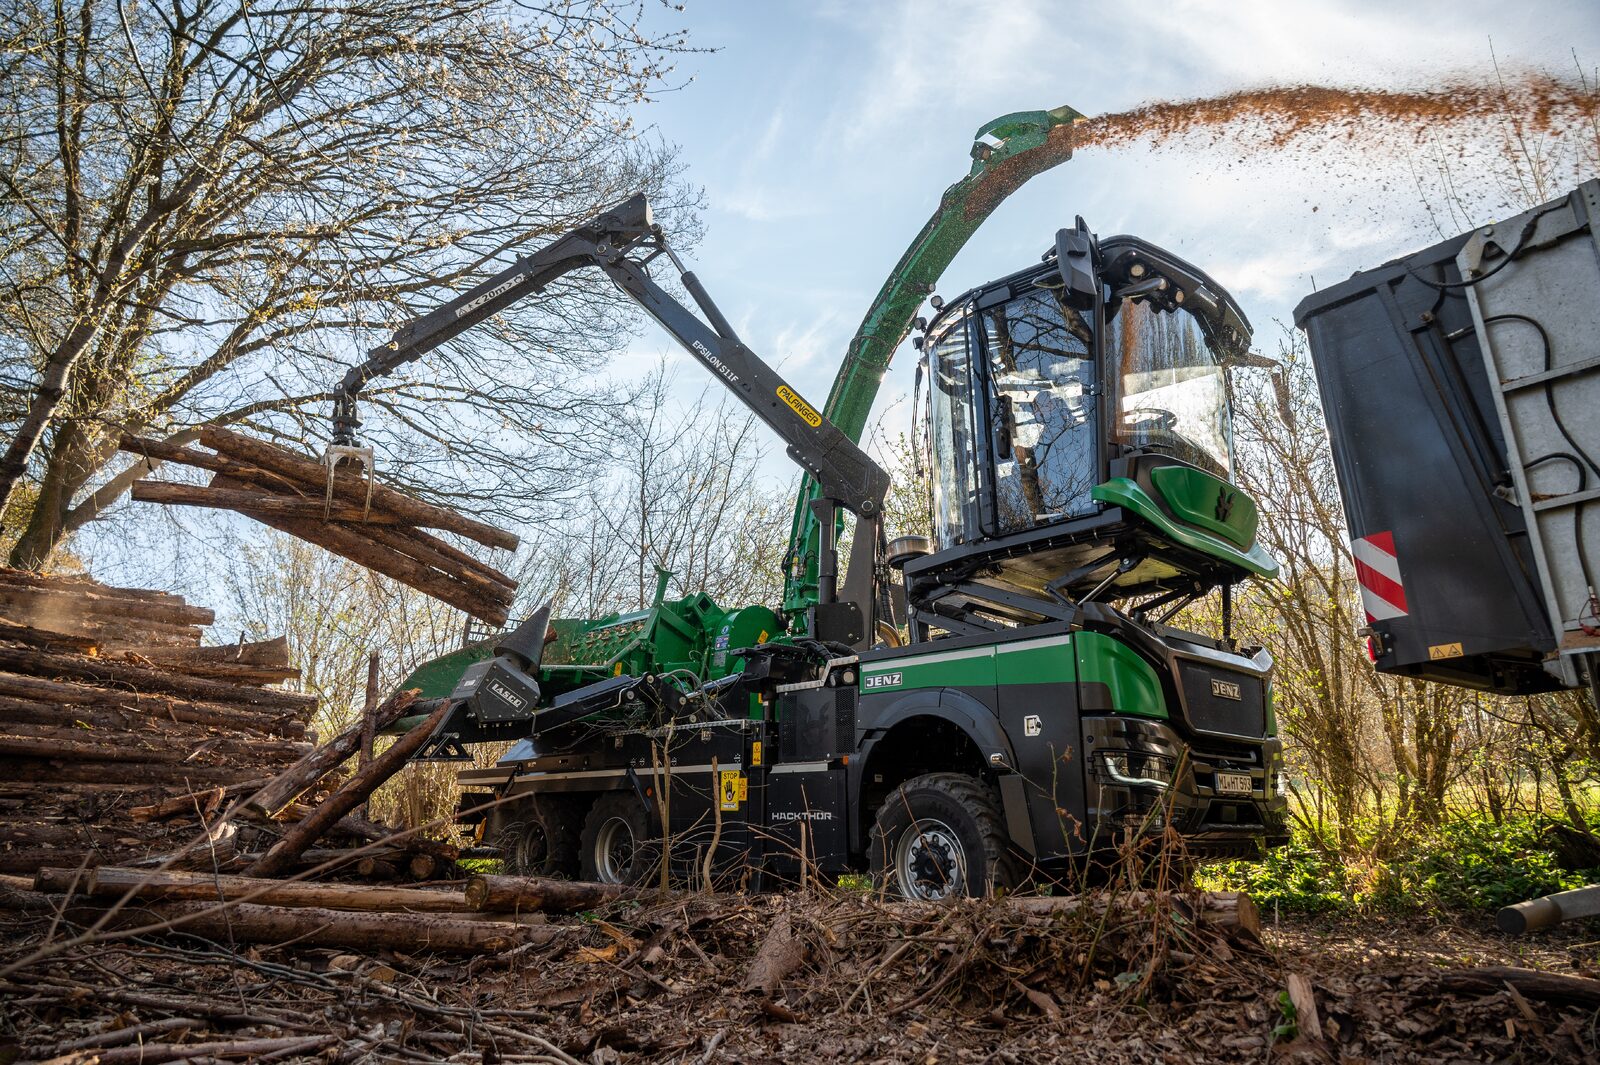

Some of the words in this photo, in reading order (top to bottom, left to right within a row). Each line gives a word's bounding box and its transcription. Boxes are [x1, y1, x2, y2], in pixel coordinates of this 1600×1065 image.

[482, 286, 507, 302] 20m
[692, 340, 722, 368] EPSILON
[719, 365, 739, 382] S11F
[779, 388, 819, 425] PALFINGER
[866, 674, 901, 687] JENZ
[491, 683, 522, 708] LASCO
[1213, 682, 1240, 698] JENZ
[723, 772, 738, 780] STOP
[771, 812, 832, 820] HACKTHOR
